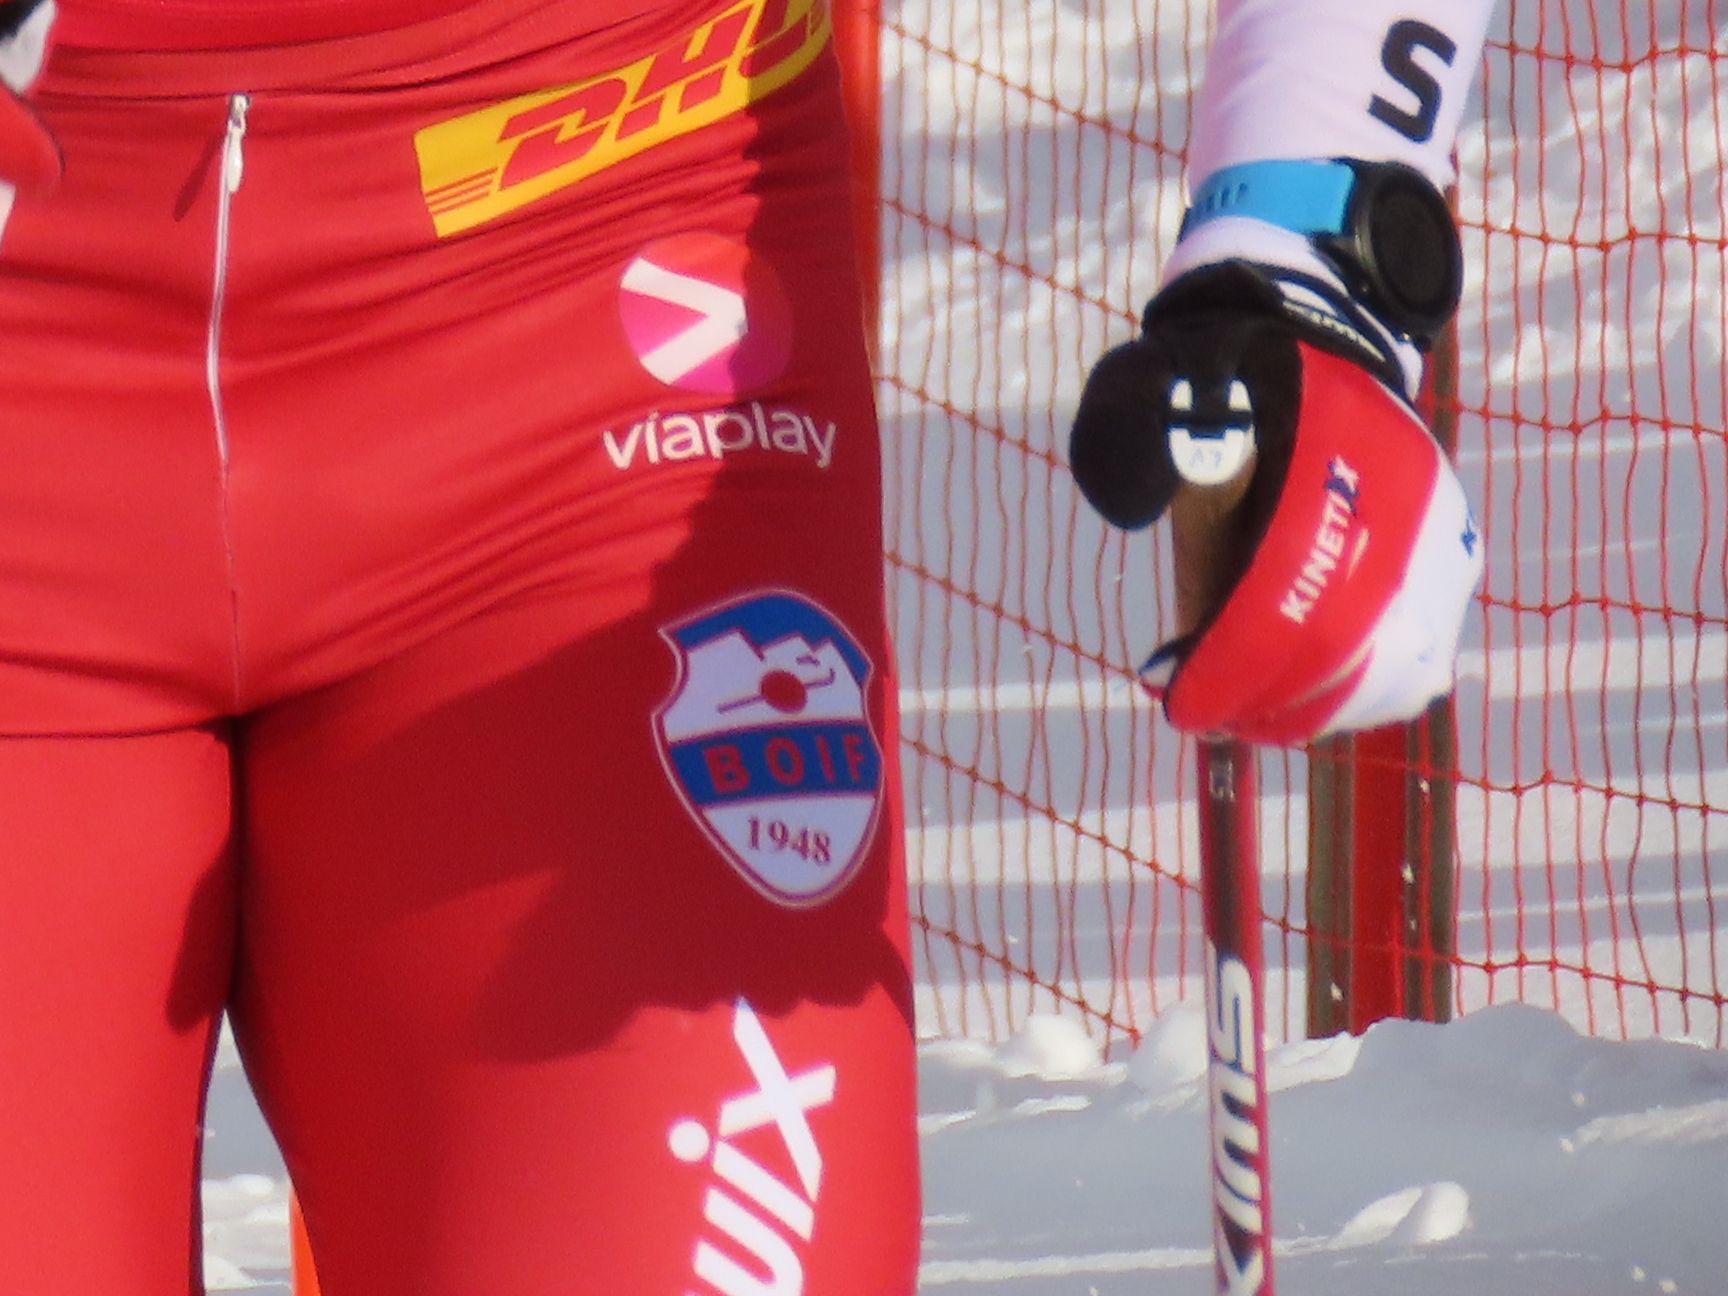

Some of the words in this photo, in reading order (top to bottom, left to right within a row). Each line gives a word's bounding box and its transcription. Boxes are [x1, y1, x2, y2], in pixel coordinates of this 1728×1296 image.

[603, 402, 836, 471] viaplay
[703, 729, 868, 794] BOIF
[745, 816, 833, 867] 1948
